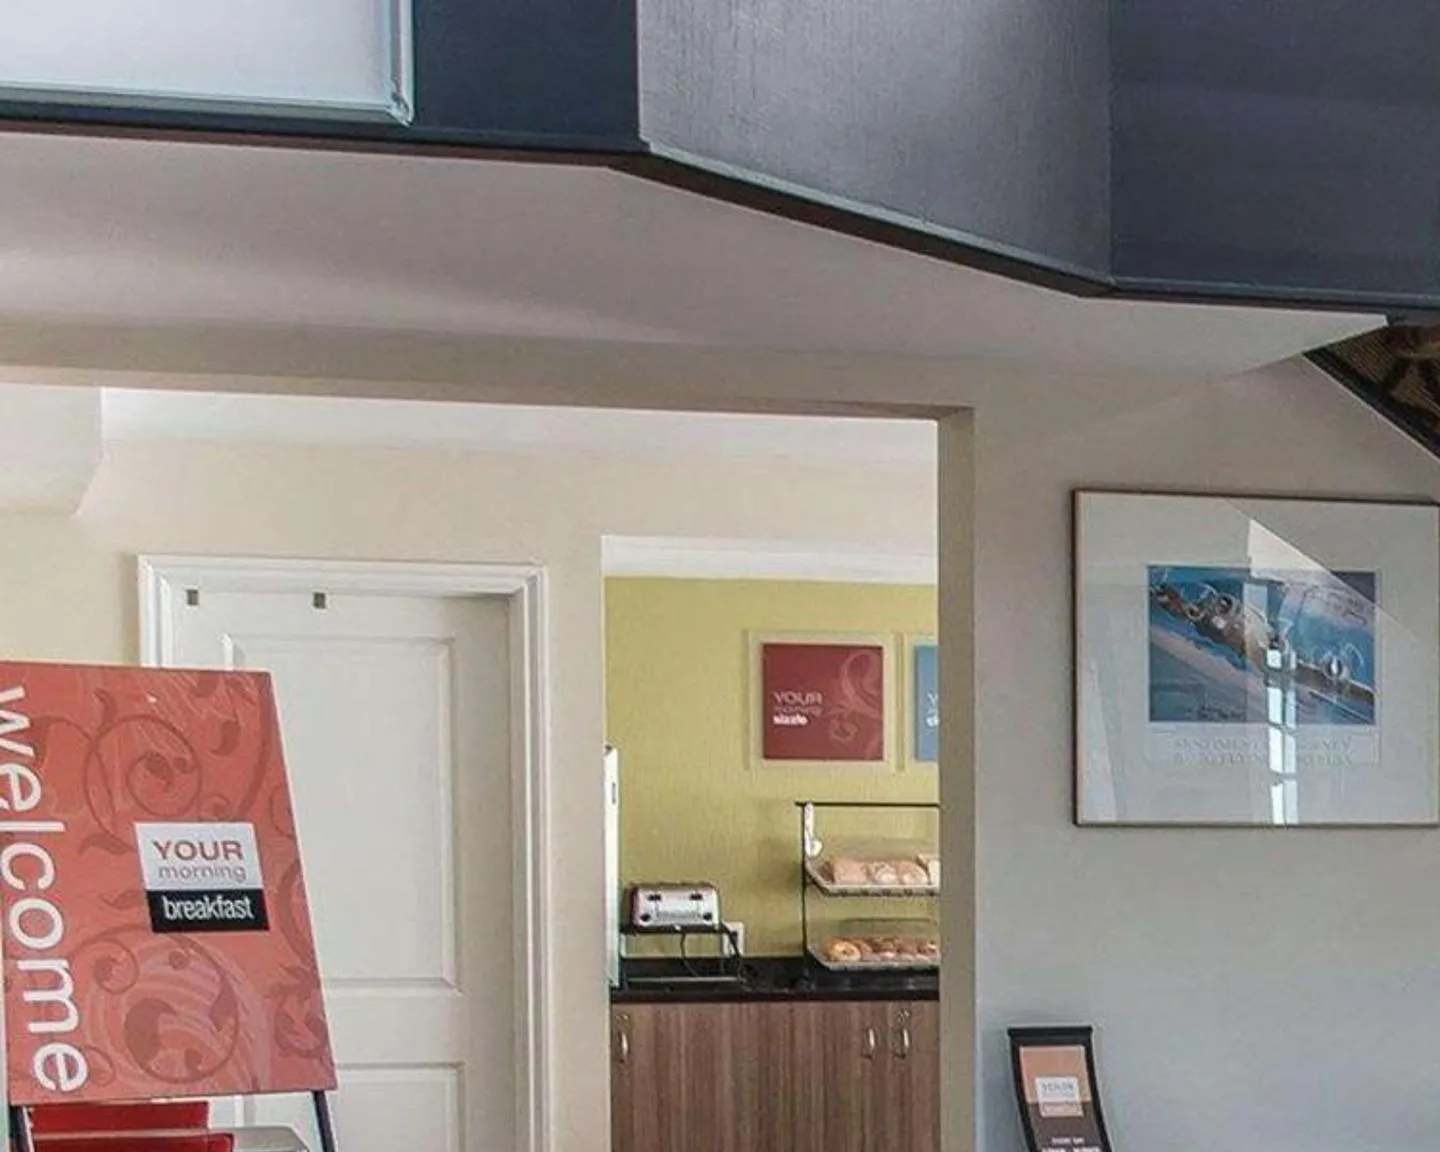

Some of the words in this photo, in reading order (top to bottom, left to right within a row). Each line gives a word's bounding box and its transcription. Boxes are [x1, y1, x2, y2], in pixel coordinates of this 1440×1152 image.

[773, 691, 822, 706] YOUR
[152, 839, 244, 861] YOUR
[159, 865, 247, 882] morning
[0, 685, 88, 1092] welcome
[162, 895, 255, 920] breakfast
